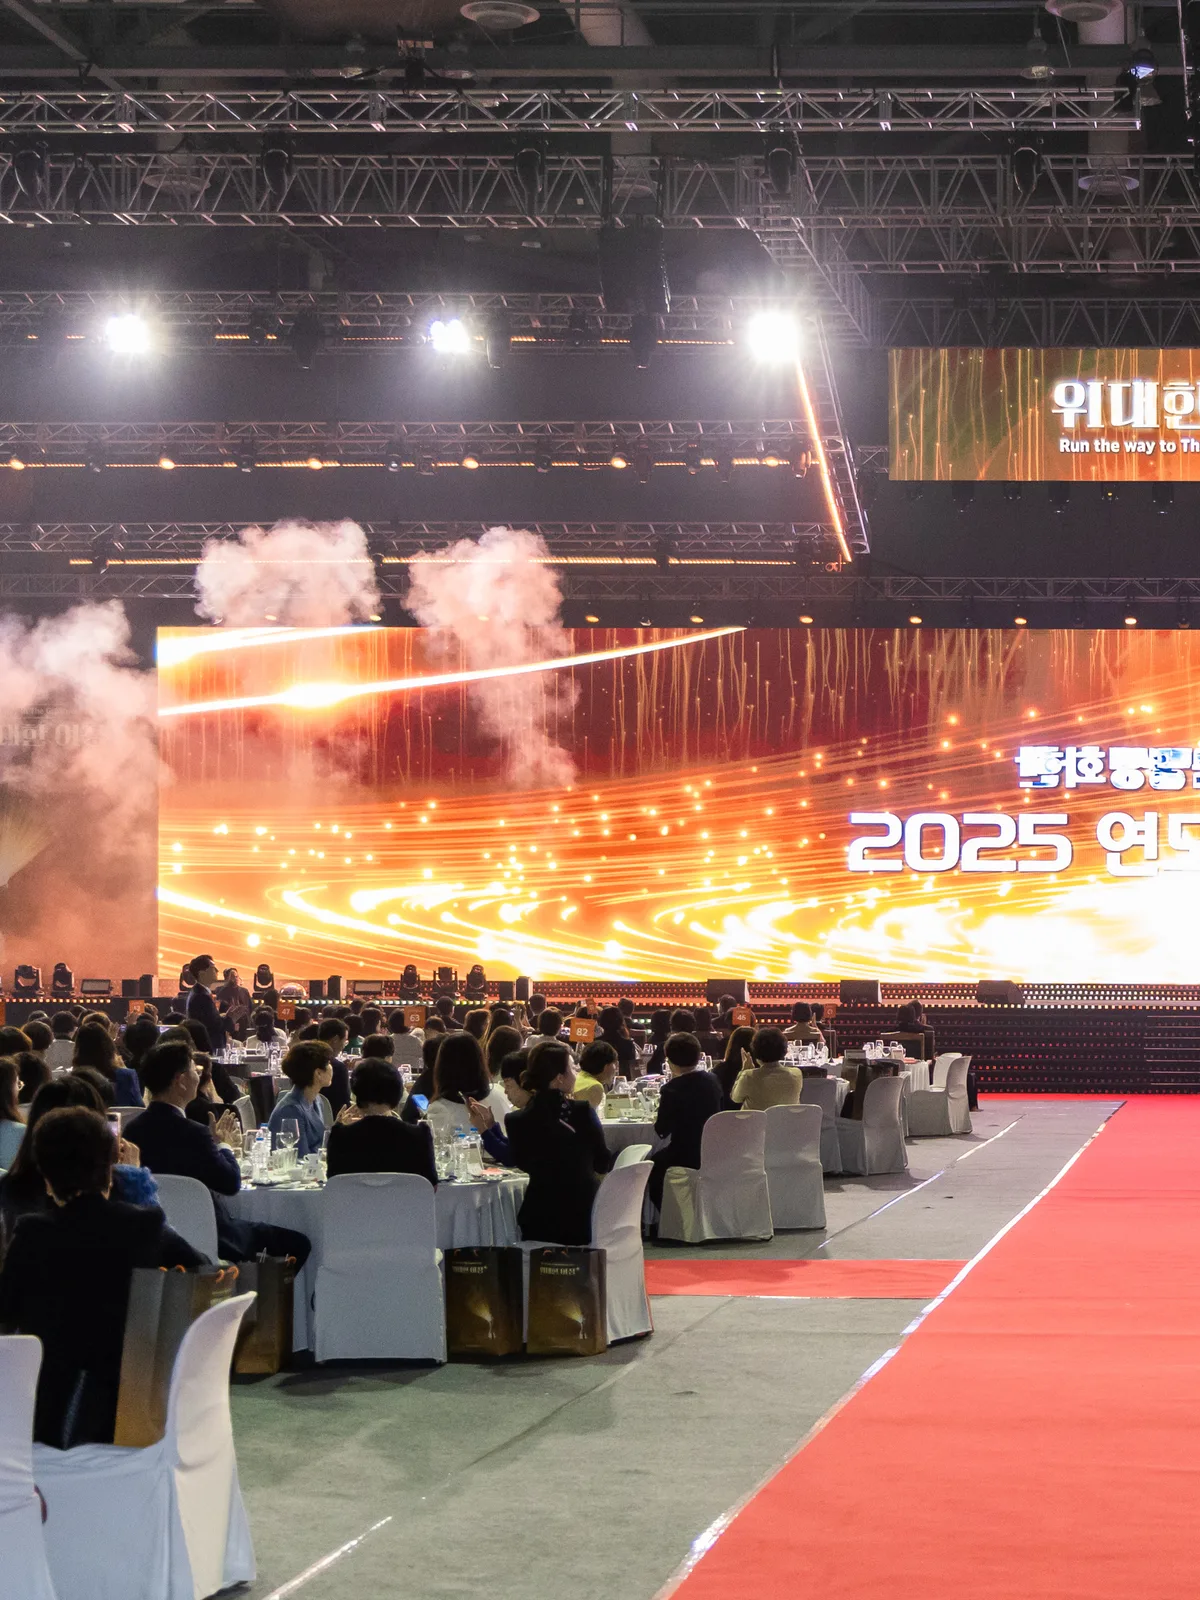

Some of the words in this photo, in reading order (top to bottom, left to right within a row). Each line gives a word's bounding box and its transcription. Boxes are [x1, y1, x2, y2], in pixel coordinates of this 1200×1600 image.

[1059, 438, 1089, 454] Run
[1094, 438, 1121, 454] the
[1124, 441, 1155, 456] way
[1159, 439, 1176, 454] to
[848, 812, 1073, 873] 2025
[409, 1014, 421, 1022] 63
[576, 1027, 589, 1037] 82
